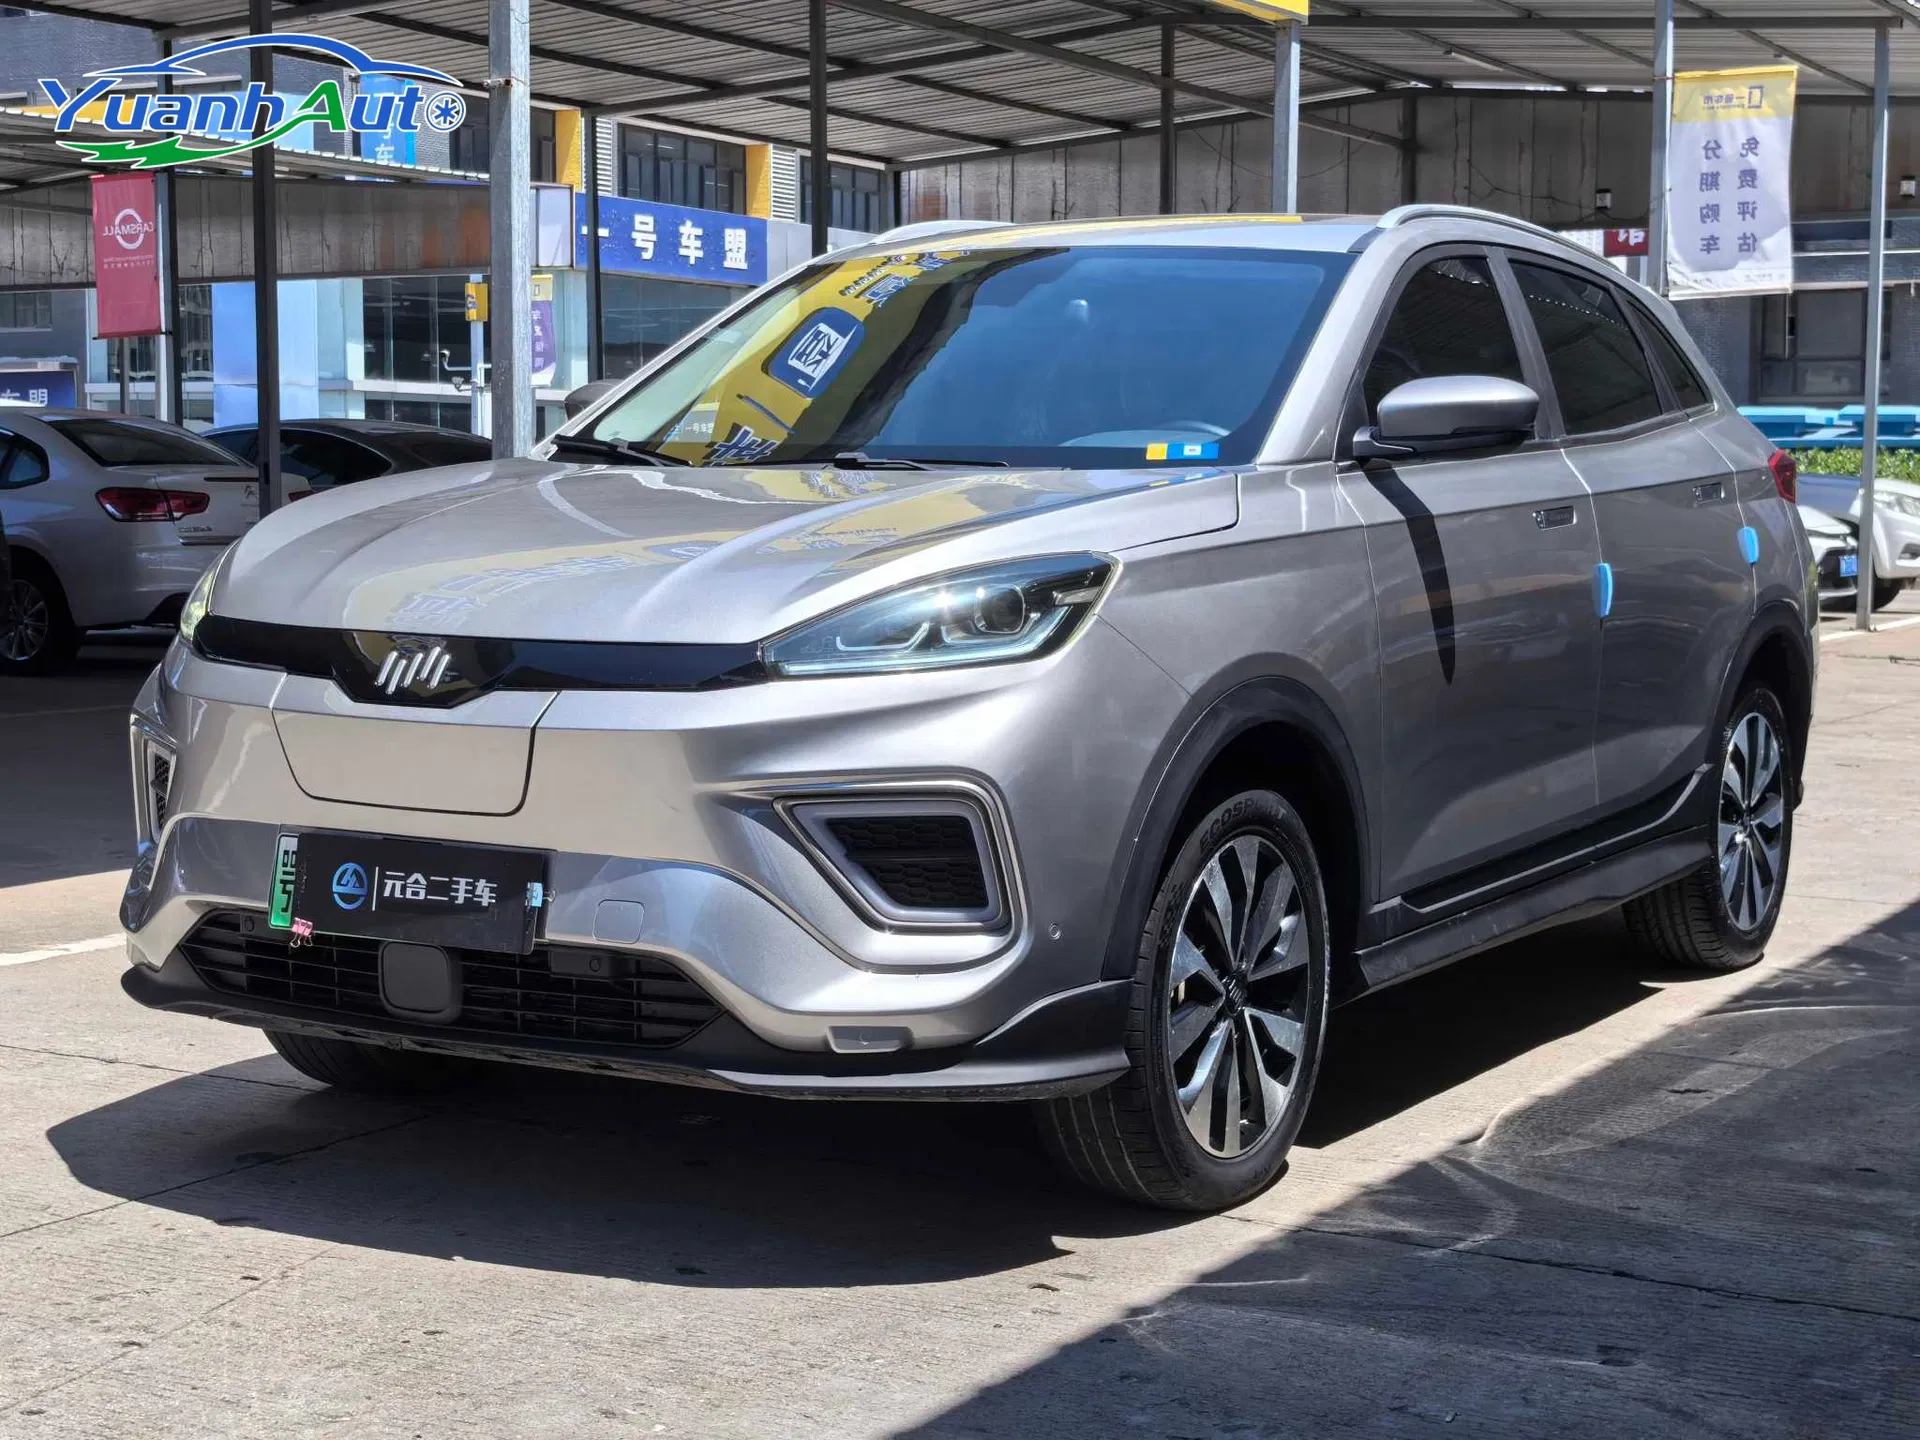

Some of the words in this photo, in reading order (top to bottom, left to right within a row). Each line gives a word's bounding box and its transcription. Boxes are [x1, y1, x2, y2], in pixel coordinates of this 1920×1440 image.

[581, 213, 748, 270] 一号车盟
[383, 871, 498, 907] 元合二手车
